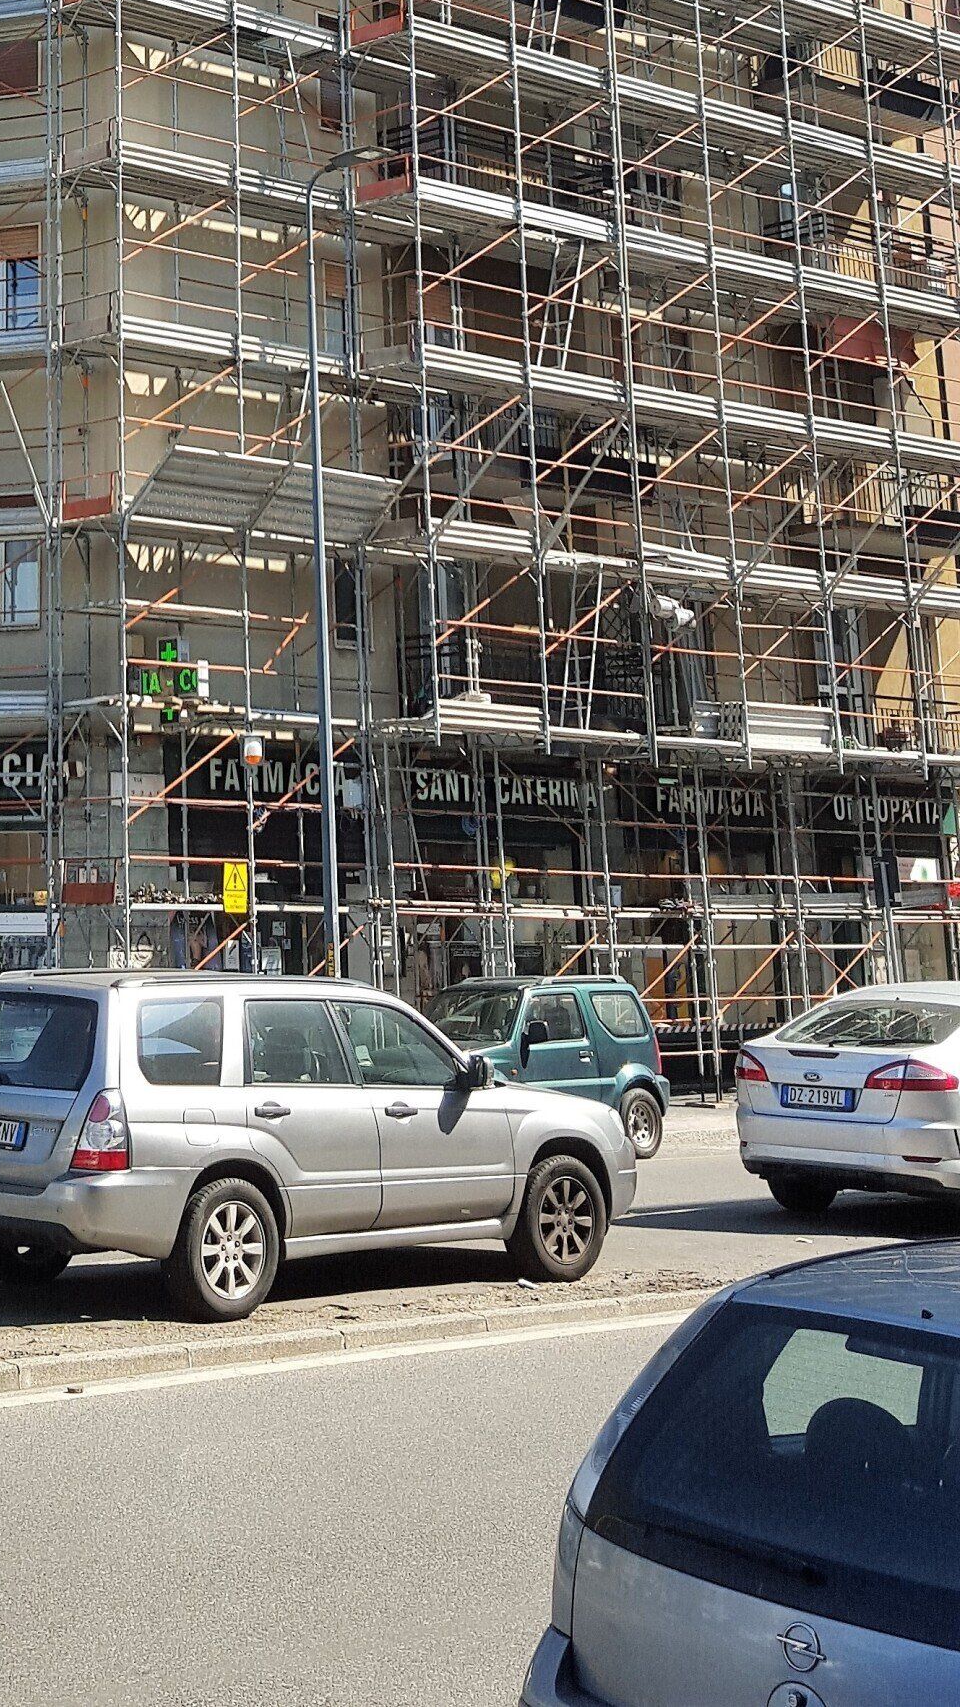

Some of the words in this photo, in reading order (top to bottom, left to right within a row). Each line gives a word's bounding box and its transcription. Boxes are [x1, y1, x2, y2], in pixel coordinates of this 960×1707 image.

[209, 757, 346, 796] FARMACA
[657, 786, 764, 817] FARMACIA
[790, 1087, 803, 1102] DZ
[808, 1089, 843, 1105] 219VL
